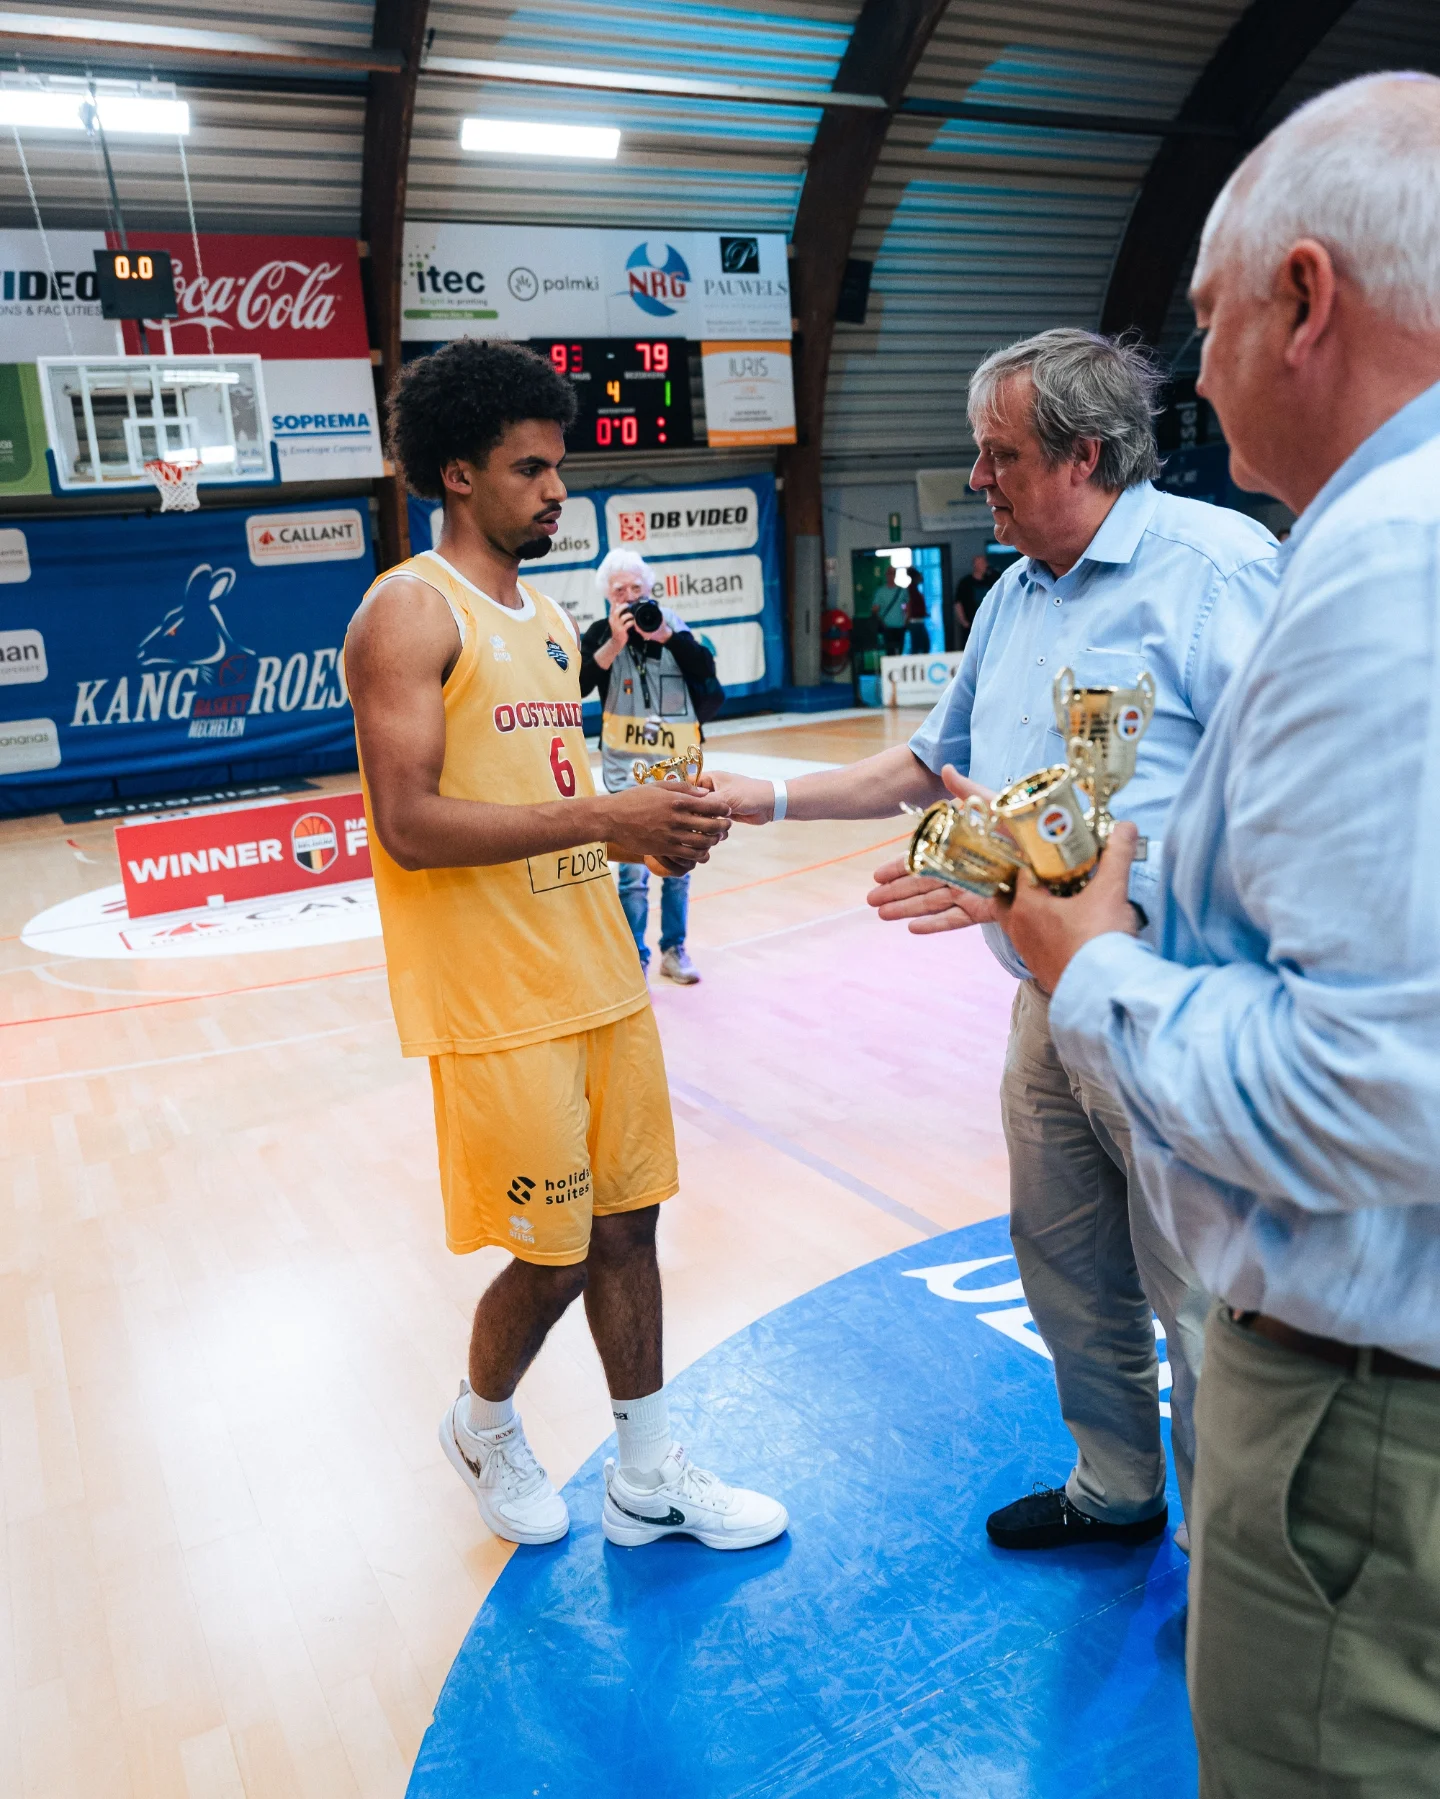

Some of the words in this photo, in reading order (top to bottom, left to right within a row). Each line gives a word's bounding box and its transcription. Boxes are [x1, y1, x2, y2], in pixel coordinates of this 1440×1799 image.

[115, 256, 153, 279] 0.0
[417, 261, 485, 294] itec
[0, 271, 101, 301] IDEO
[145, 258, 343, 330] oca-Cola
[543, 276, 599, 294] palmki
[628, 271, 688, 299] NRG
[704, 278, 788, 296] PAUWELS
[26, 306, 34, 316] &
[38, 306, 103, 317] FACLITIES
[635, 342, 668, 372] 79
[606, 380, 621, 404] 4
[272, 412, 371, 430] SOPREMA
[650, 511, 682, 530] DB
[686, 506, 748, 527] VIDEO
[280, 523, 354, 544] CALLANT
[651, 574, 744, 599] ellikaan
[0, 643, 39, 663] an
[70, 668, 200, 728] KANG
[247, 648, 348, 715] ROES
[187, 717, 247, 739] MECHELEN
[549, 736, 577, 798] 6
[127, 838, 283, 884] WINNER
[545, 1168, 591, 1191] holida
[546, 1183, 590, 1205] suites
